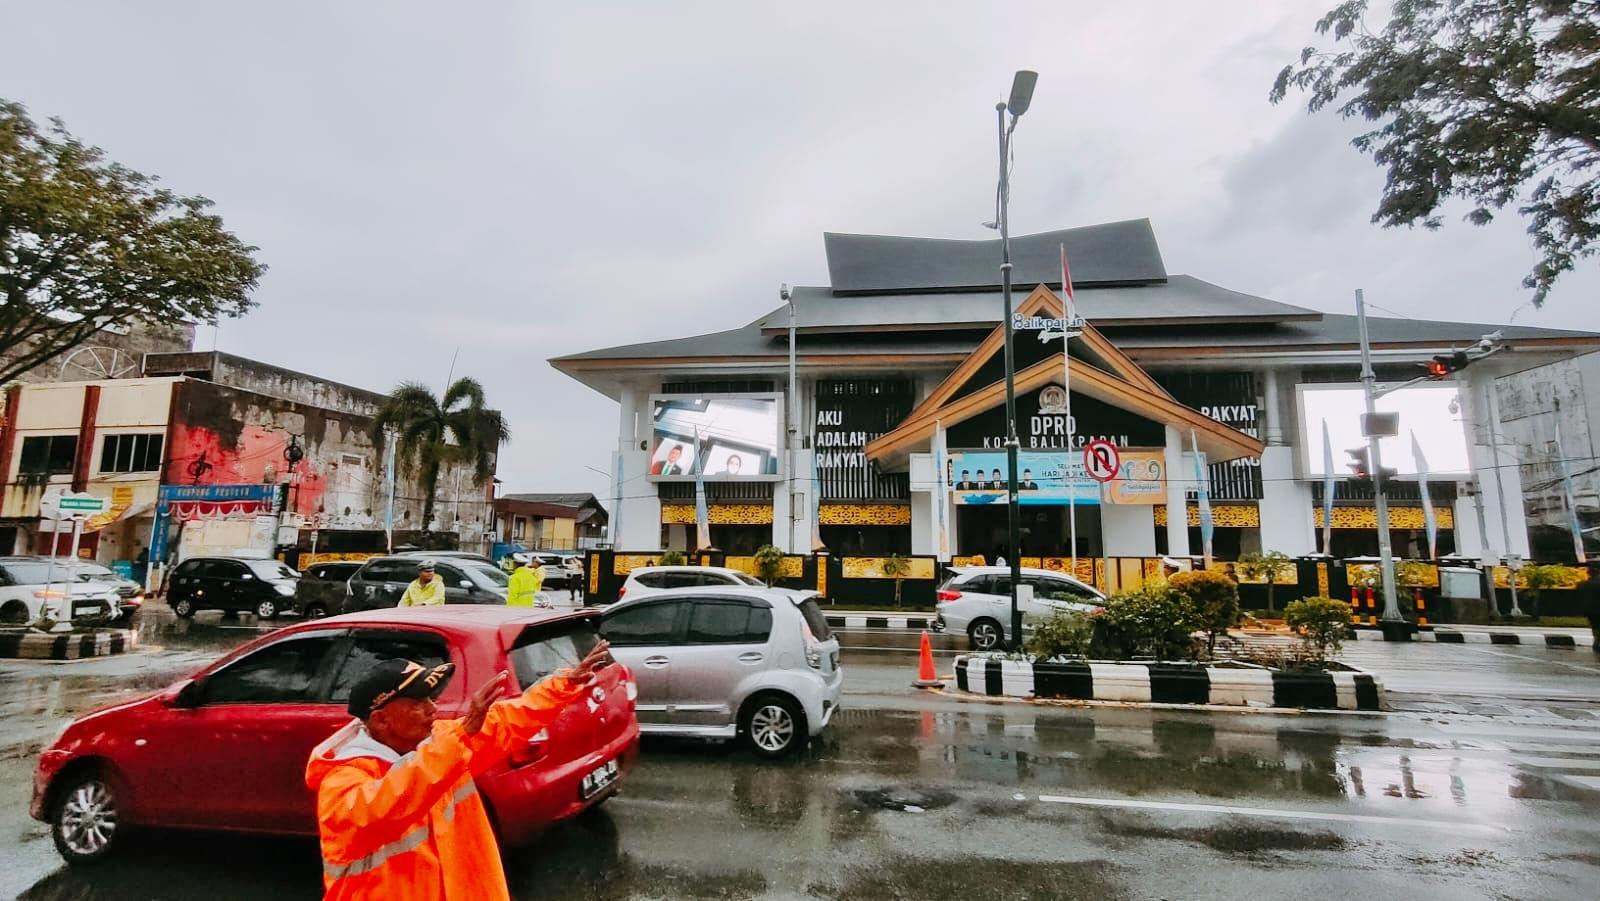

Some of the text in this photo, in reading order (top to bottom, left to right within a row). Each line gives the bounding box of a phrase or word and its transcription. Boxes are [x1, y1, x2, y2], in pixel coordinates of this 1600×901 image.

[817, 411, 842, 425] AKU
[1201, 405, 1256, 421] RAKYAT
[1031, 416, 1076, 435] DPRD
[817, 432, 865, 446] ADALAH
[983, 436, 1020, 448] KOA
[816, 453, 865, 468] RAKYAT
